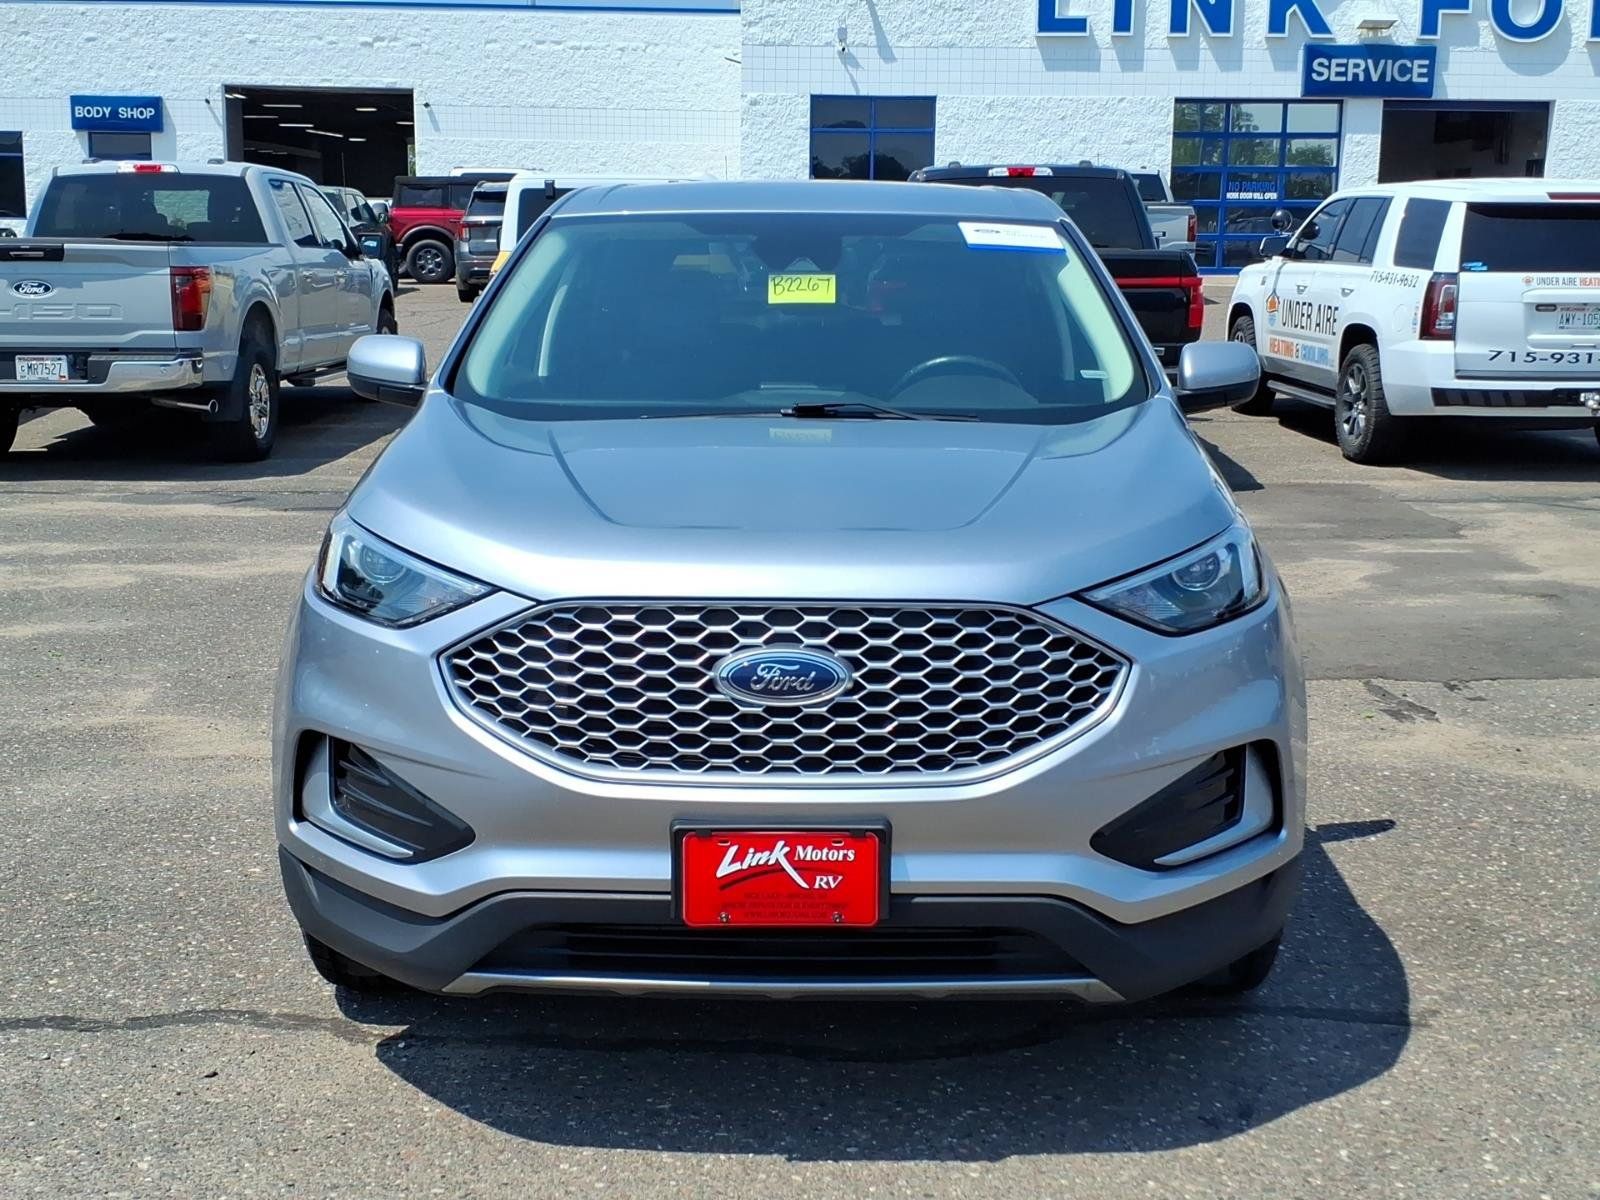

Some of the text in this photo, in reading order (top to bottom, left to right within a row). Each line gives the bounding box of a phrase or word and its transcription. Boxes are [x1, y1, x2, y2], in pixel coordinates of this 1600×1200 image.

[1036, 0, 1600, 42] LINK FO
[1311, 57, 1430, 83] SERVICE
[74, 106, 155, 119] BODY SHOP
[18, 281, 45, 294] Ford
[771, 276, 832, 296] B2267
[1369, 270, 1420, 288] 715-931-9632
[1536, 276, 1560, 287] UNDER
[1561, 276, 1577, 287] AIRE
[1281, 299, 1339, 336] UNDER AIRE
[1488, 349, 1600, 364] 715-931
[27, 362, 62, 375] MR7527
[750, 663, 817, 691] Ford
[715, 840, 855, 889] Link Motors
[813, 875, 844, 889] RV
